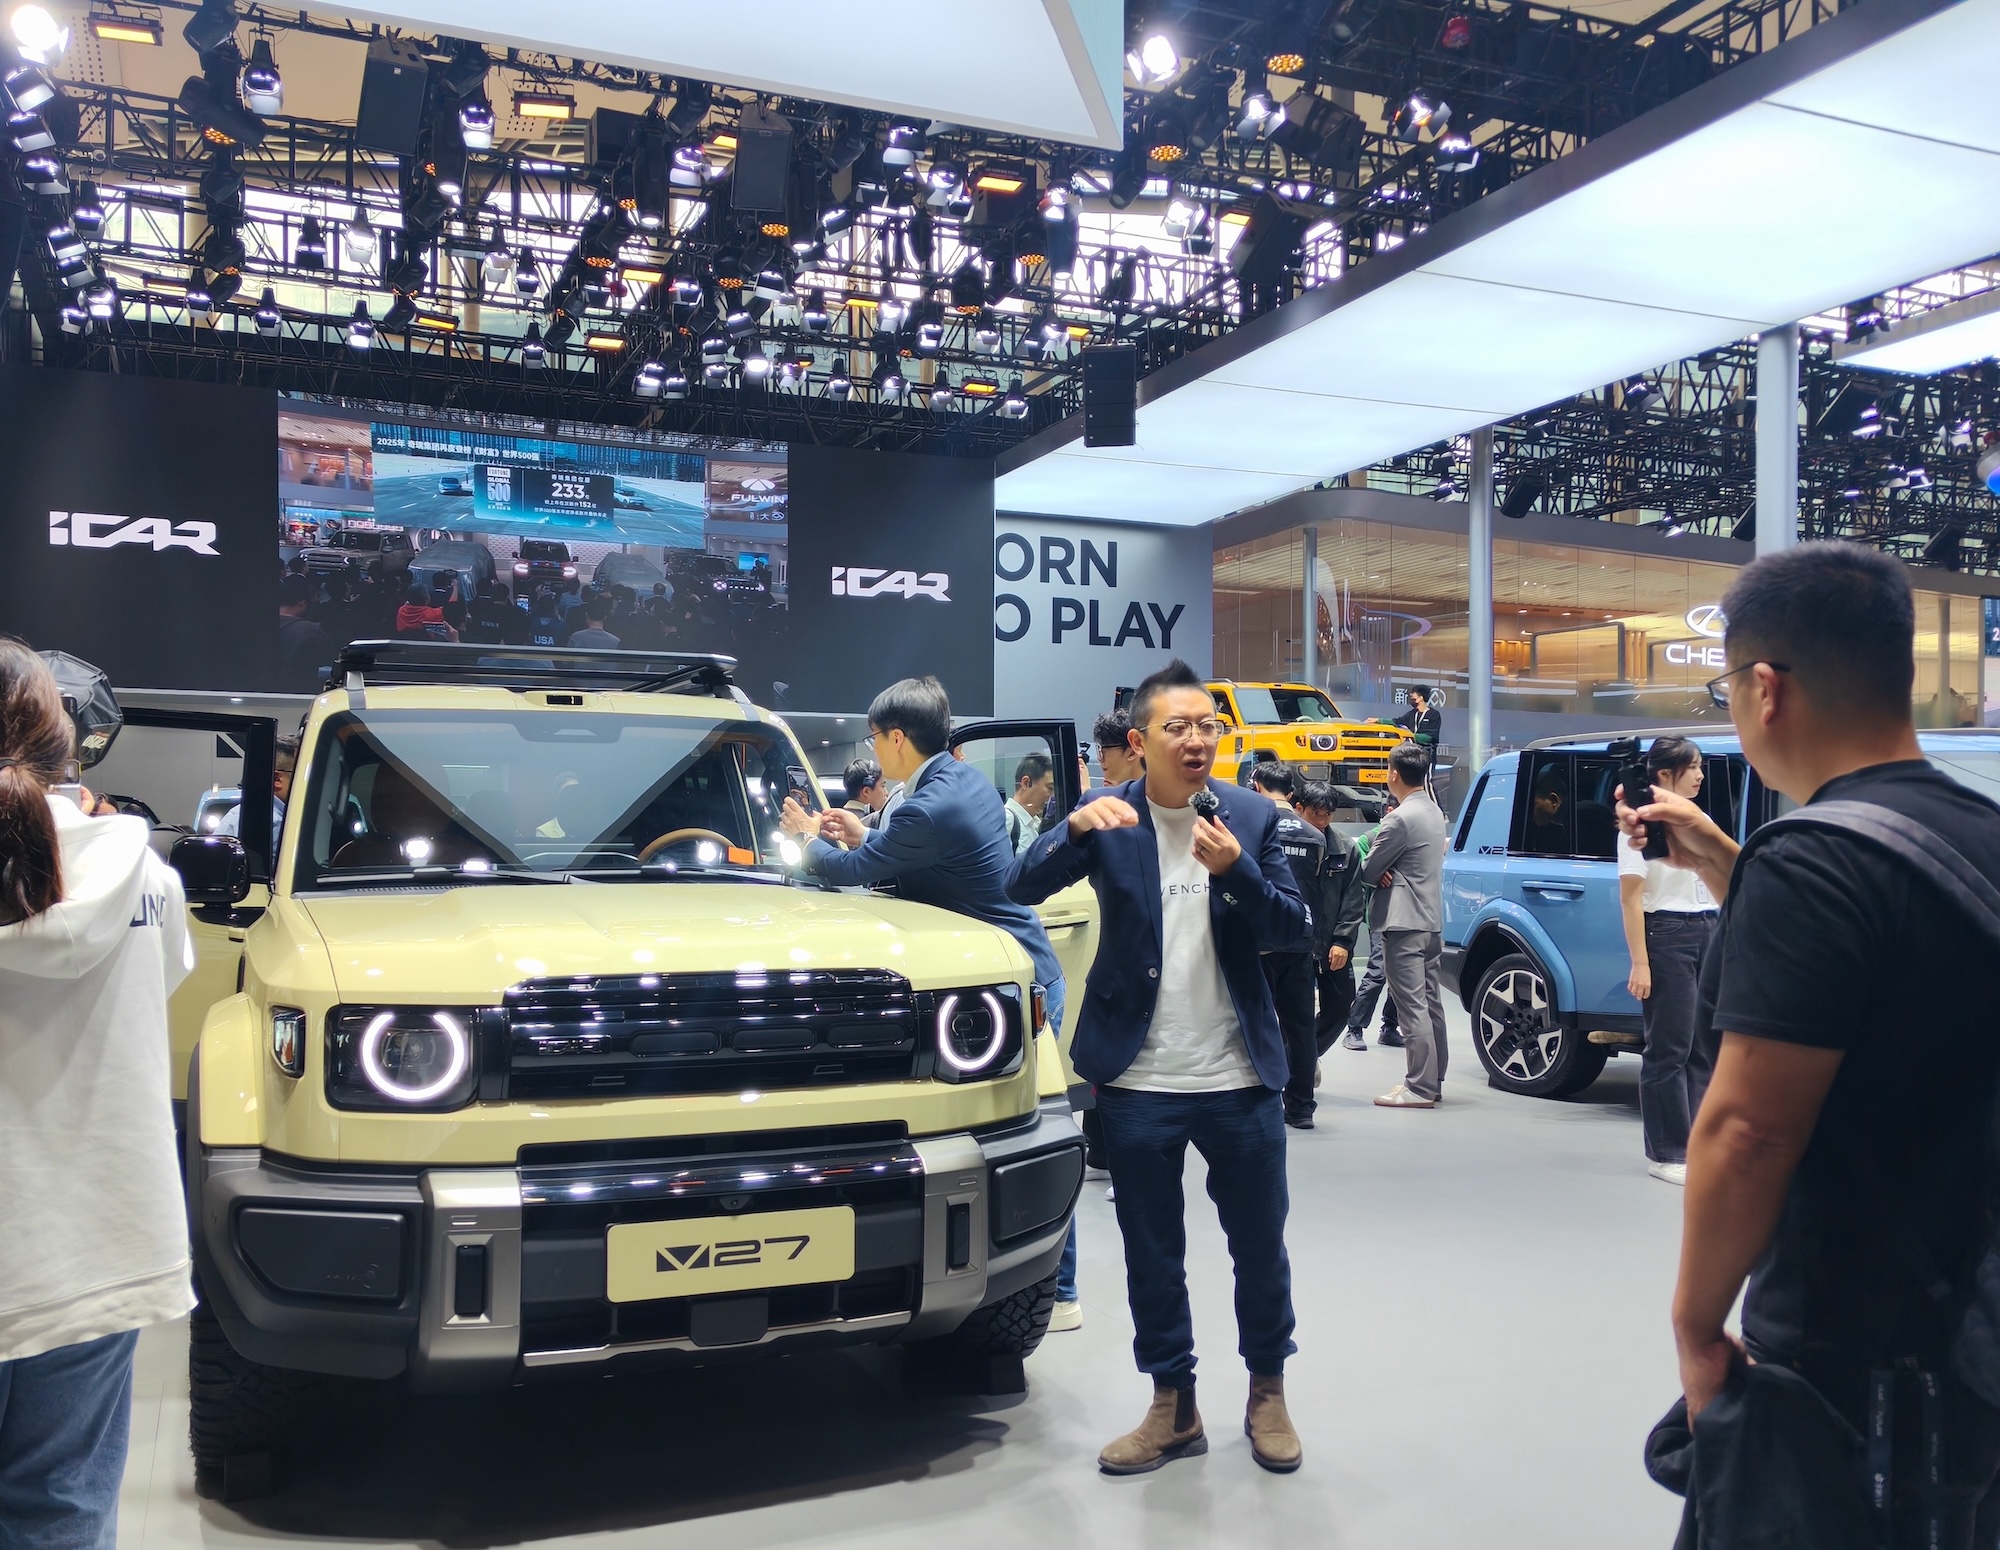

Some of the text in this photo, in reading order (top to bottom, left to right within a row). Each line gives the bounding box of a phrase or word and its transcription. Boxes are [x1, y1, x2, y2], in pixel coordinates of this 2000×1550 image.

[487, 483, 511, 502] 500
[731, 494, 785, 503] FULWIN
[995, 532, 1118, 588] ORN
[995, 593, 1186, 650] O PLAY
[534, 635, 555, 645] USA
[1666, 644, 1726, 667] CHE
[656, 1235, 810, 1273] V27
